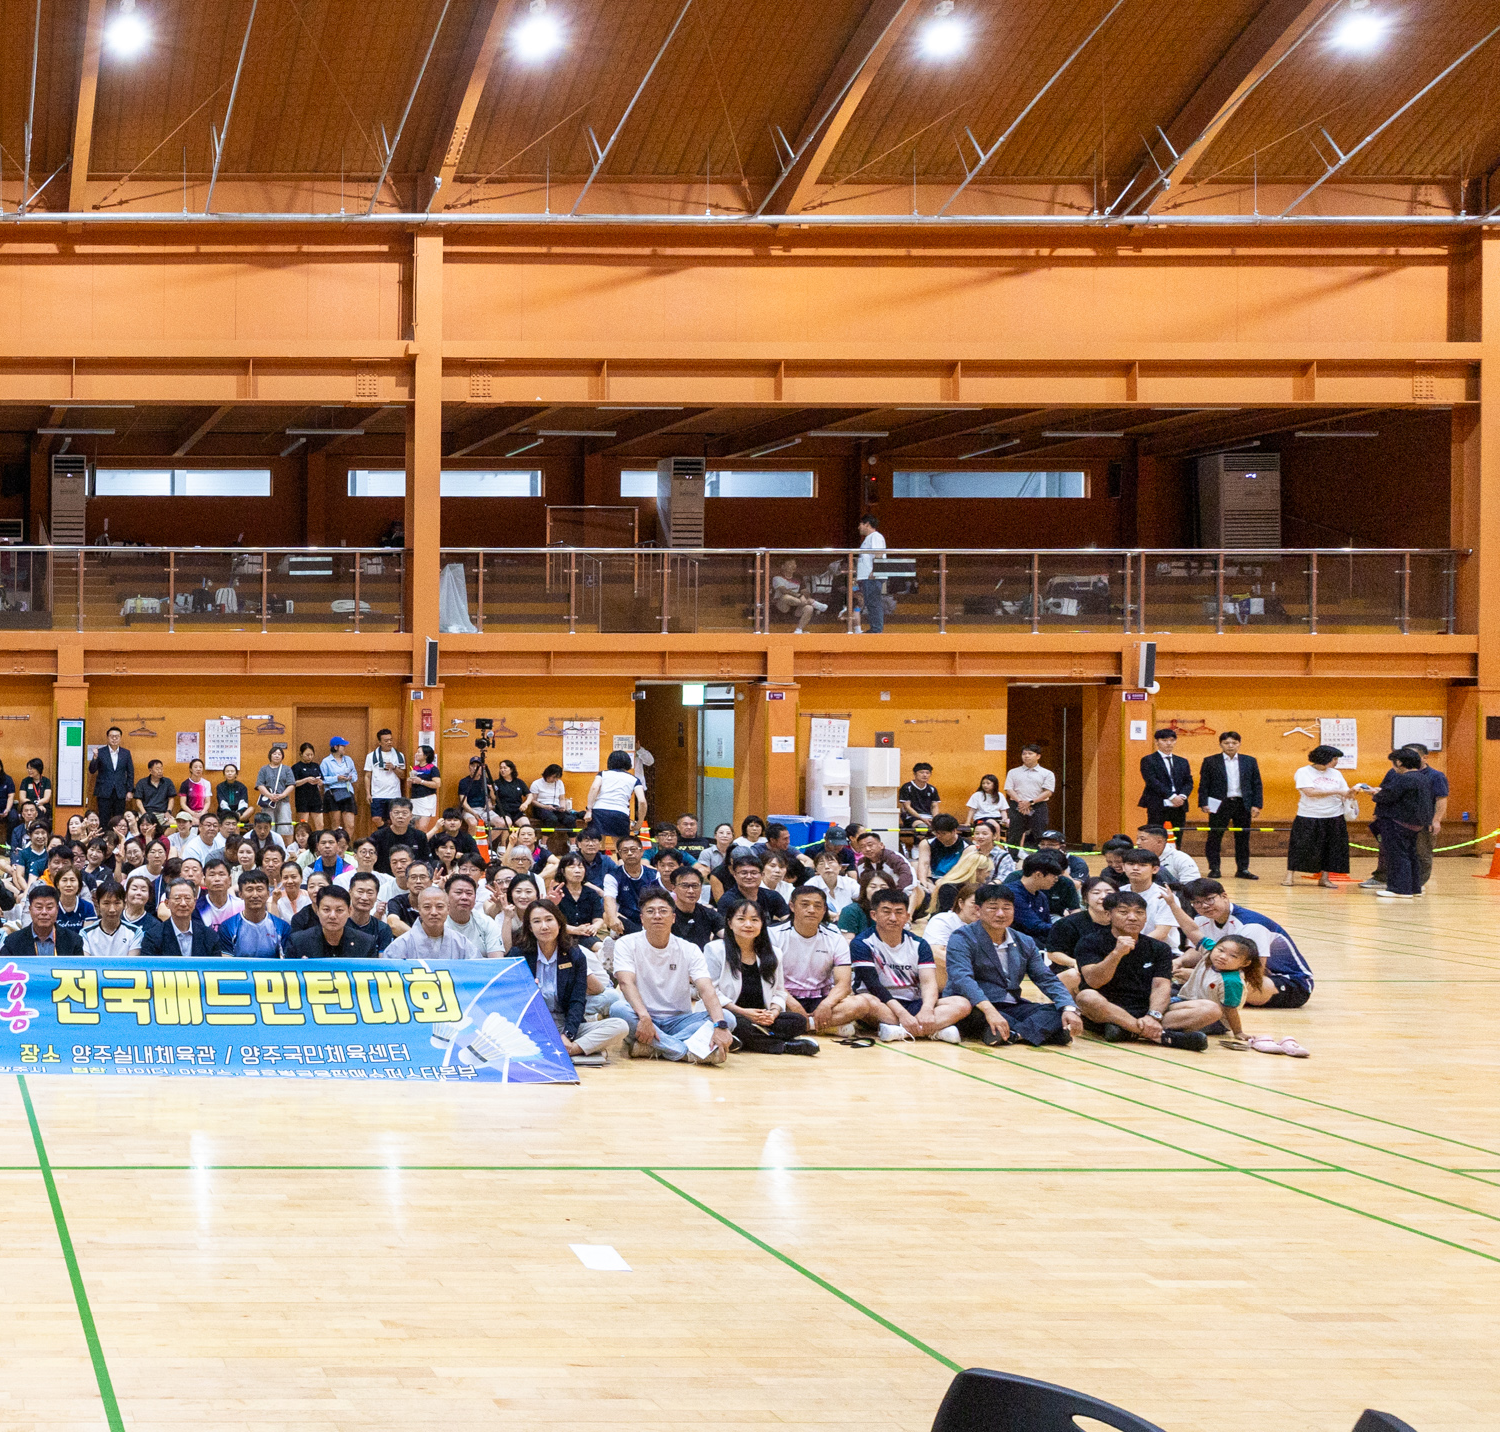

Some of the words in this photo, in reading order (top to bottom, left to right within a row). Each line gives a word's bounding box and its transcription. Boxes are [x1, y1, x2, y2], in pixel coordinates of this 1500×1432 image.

[50, 965, 464, 1026] 전국배드민턴대회
[19, 1043, 61, 1064] 장소
[71, 1044, 216, 1066] 양주실내체육관
[224, 1045, 233, 1065] /
[239, 1043, 412, 1065] 양주국민체육센터
